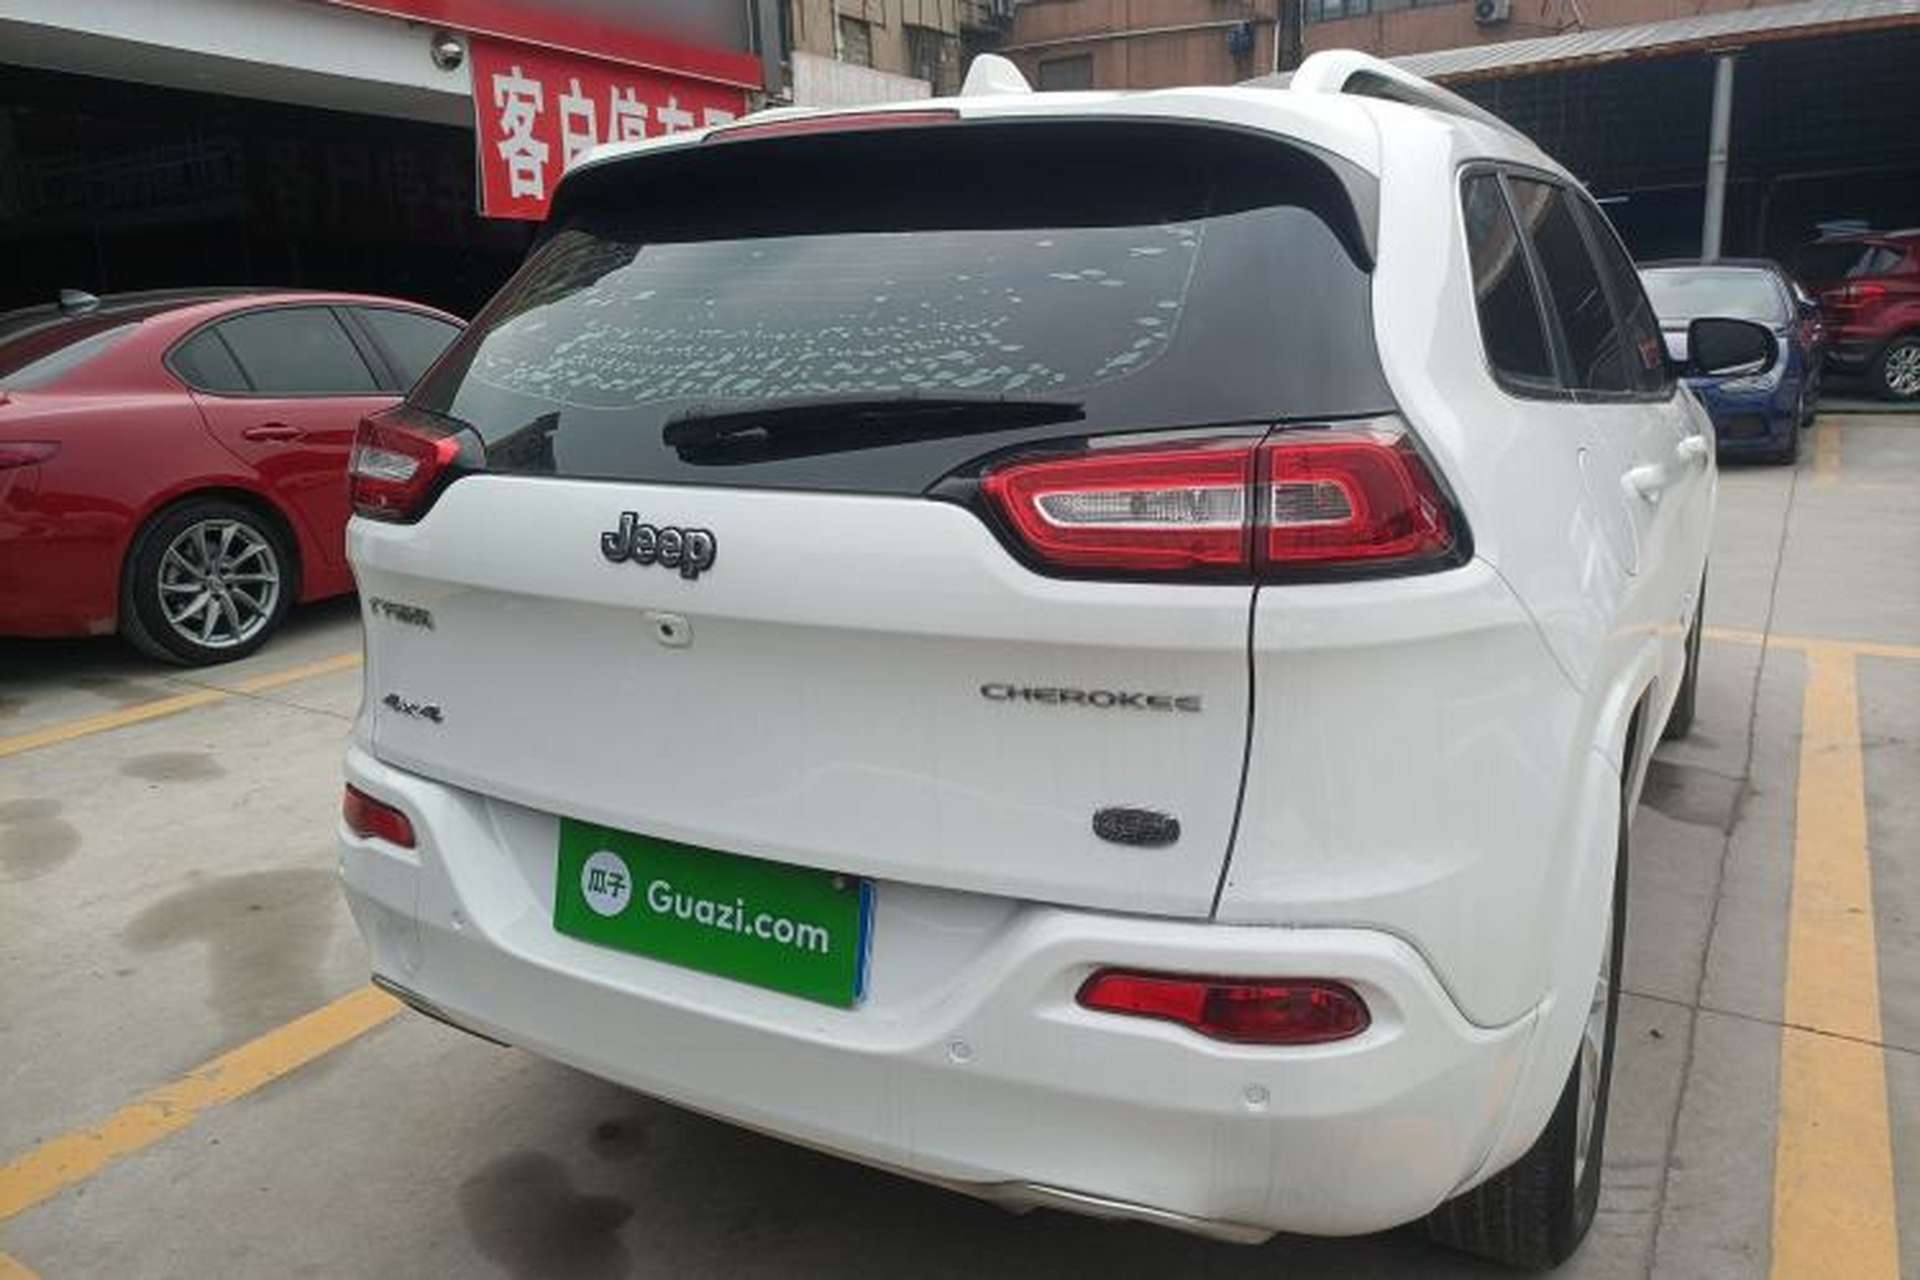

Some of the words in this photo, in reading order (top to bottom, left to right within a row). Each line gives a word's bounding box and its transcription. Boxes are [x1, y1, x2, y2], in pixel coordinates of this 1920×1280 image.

[602, 512, 717, 580] Jeep
[980, 683, 1202, 712] CHEROKEE
[587, 868, 627, 898] 瓜子
[647, 880, 830, 954] Guazi.com
